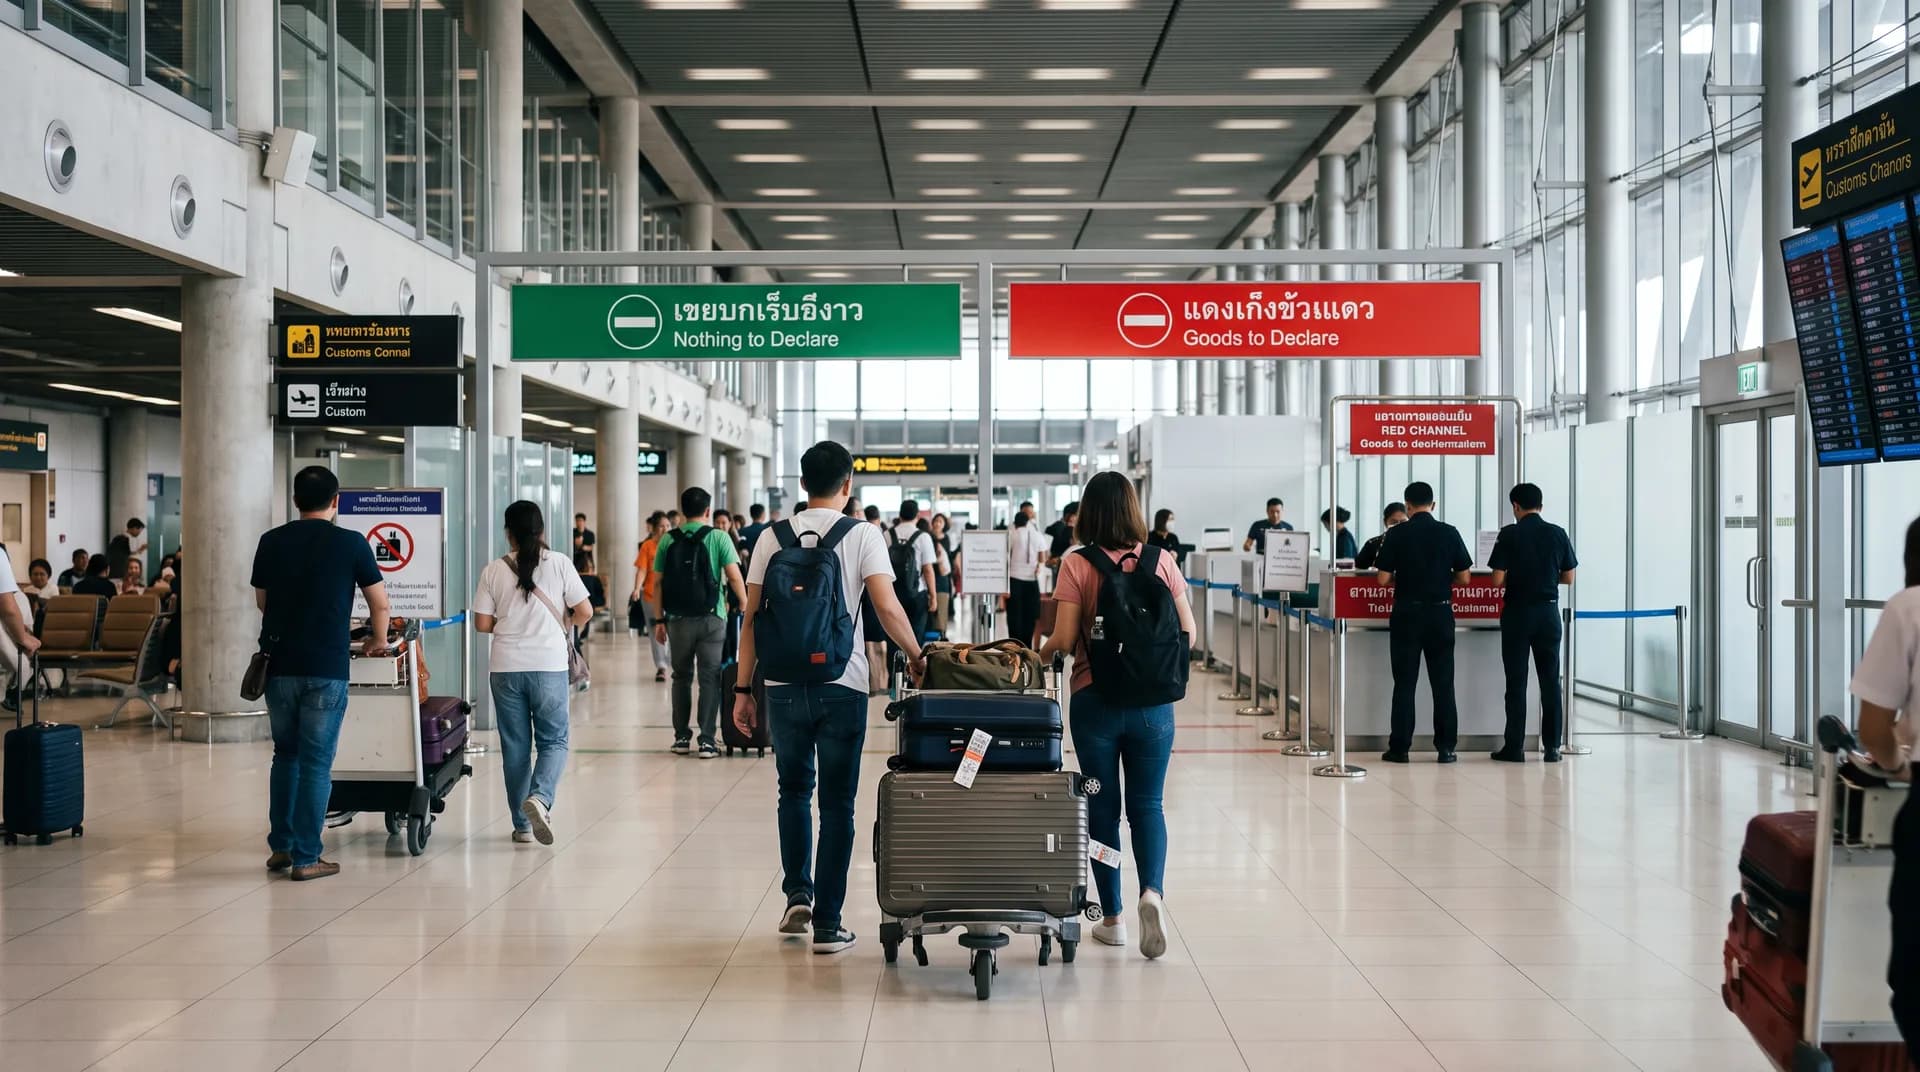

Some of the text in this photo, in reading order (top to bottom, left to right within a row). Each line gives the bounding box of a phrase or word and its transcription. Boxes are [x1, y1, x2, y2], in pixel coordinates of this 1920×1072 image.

[1826, 171, 1867, 199] Customs
[674, 331, 839, 351] Nothing to Declare
[1183, 330, 1340, 346] Goods to Declare
[325, 347, 371, 358] Customs
[325, 406, 366, 417] Custom
[1381, 425, 1467, 436] RED CHANNEL
[1360, 439, 1394, 448] Goods
[1397, 439, 1408, 448] to
